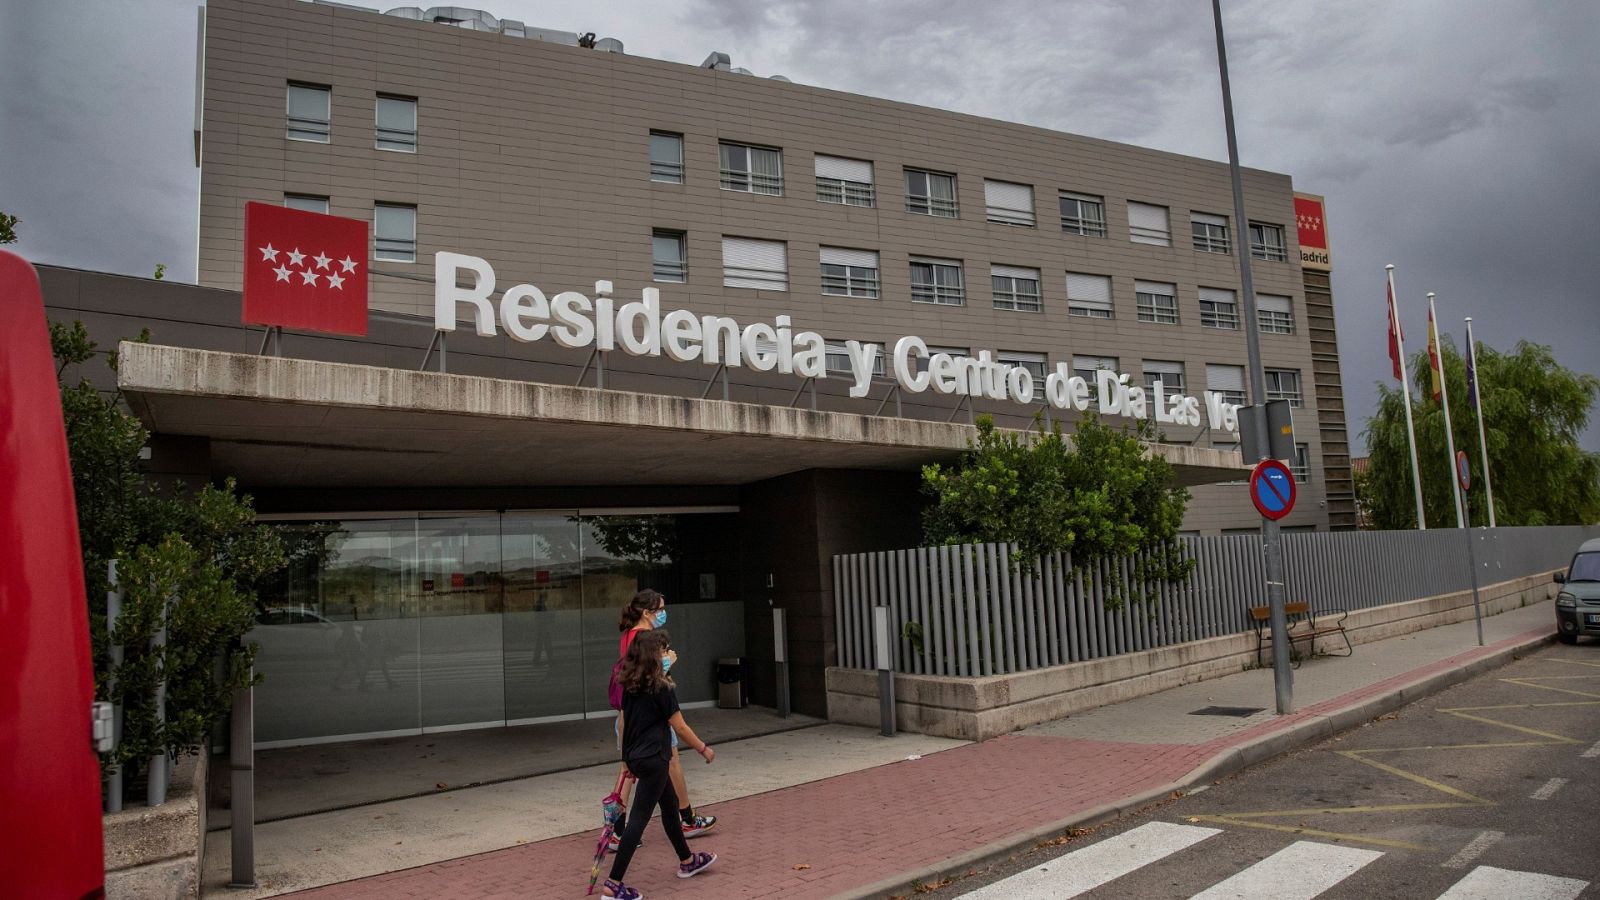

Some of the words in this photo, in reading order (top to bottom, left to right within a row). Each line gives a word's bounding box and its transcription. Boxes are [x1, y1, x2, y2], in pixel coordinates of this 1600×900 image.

[1300, 250, 1328, 264] adrid
[434, 251, 827, 378] Residencia
[845, 340, 878, 398] y
[893, 335, 1033, 404] Centro
[1046, 362, 1089, 411] de
[1097, 369, 1147, 420] Día
[1153, 380, 1200, 427] Las
